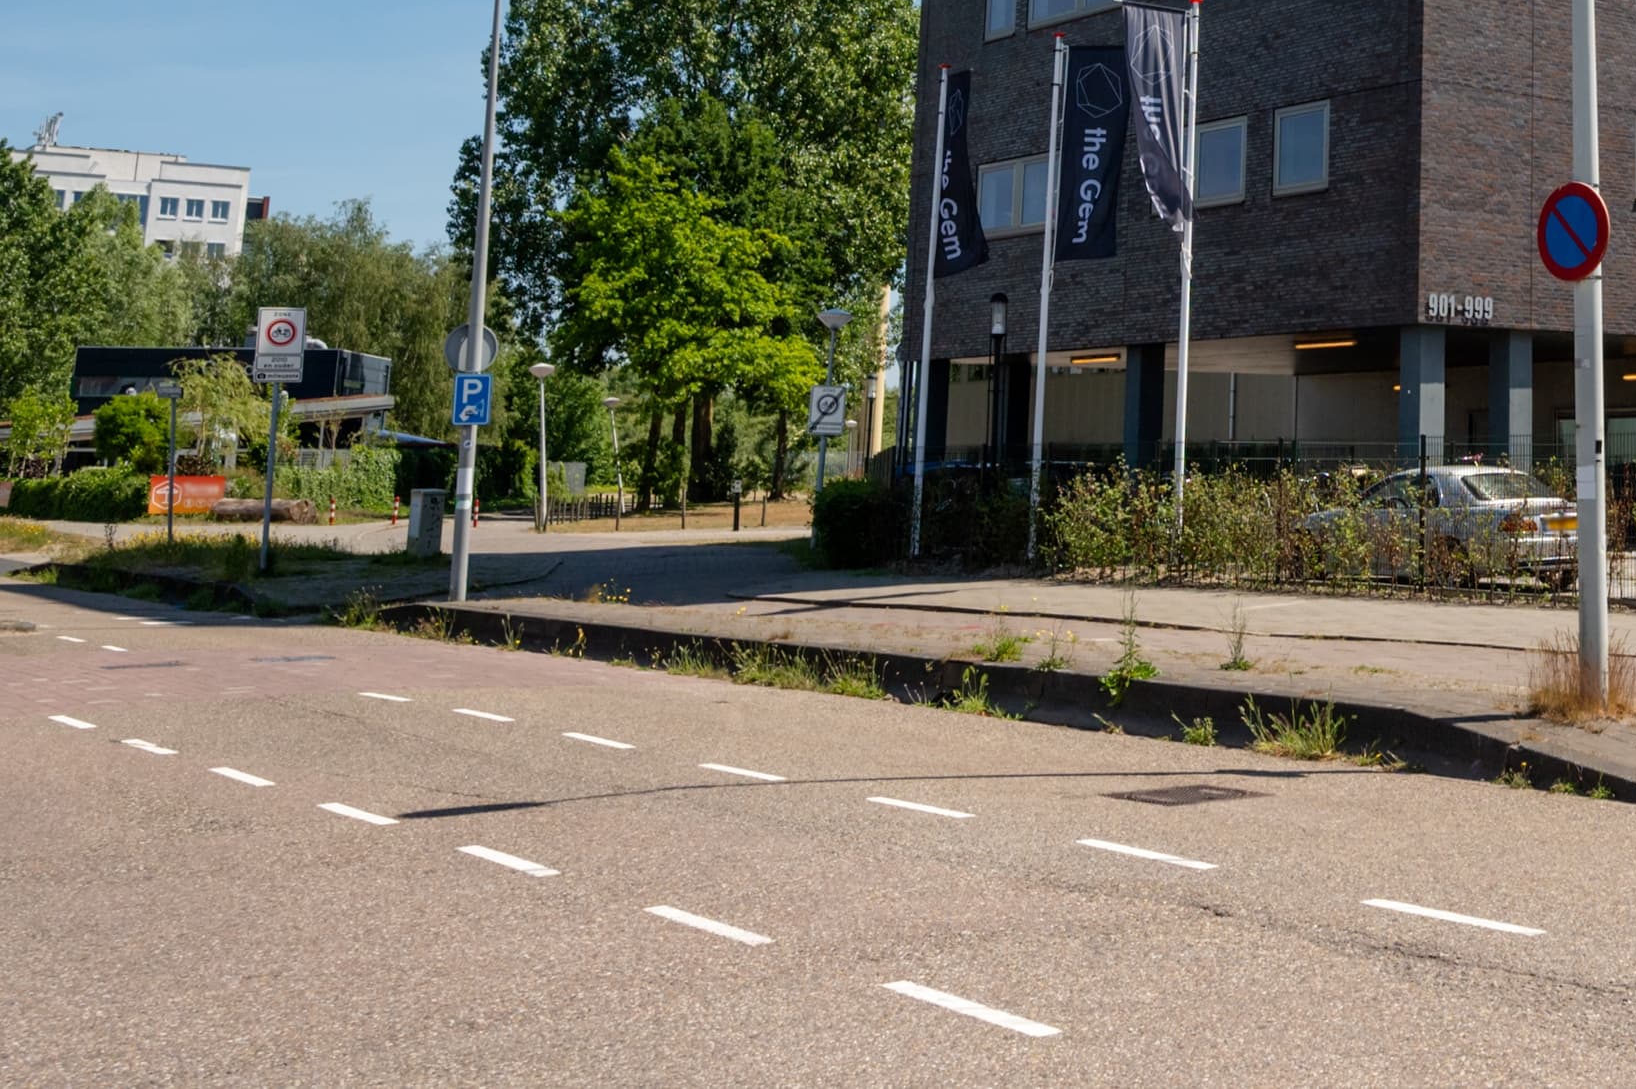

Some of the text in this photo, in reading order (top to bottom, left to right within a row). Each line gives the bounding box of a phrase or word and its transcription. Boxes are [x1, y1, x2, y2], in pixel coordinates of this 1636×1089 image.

[1072, 127, 1107, 244] the Gem
[940, 197, 962, 260] Gem
[1428, 293, 1494, 320] 901-999
[462, 378, 483, 404] P
